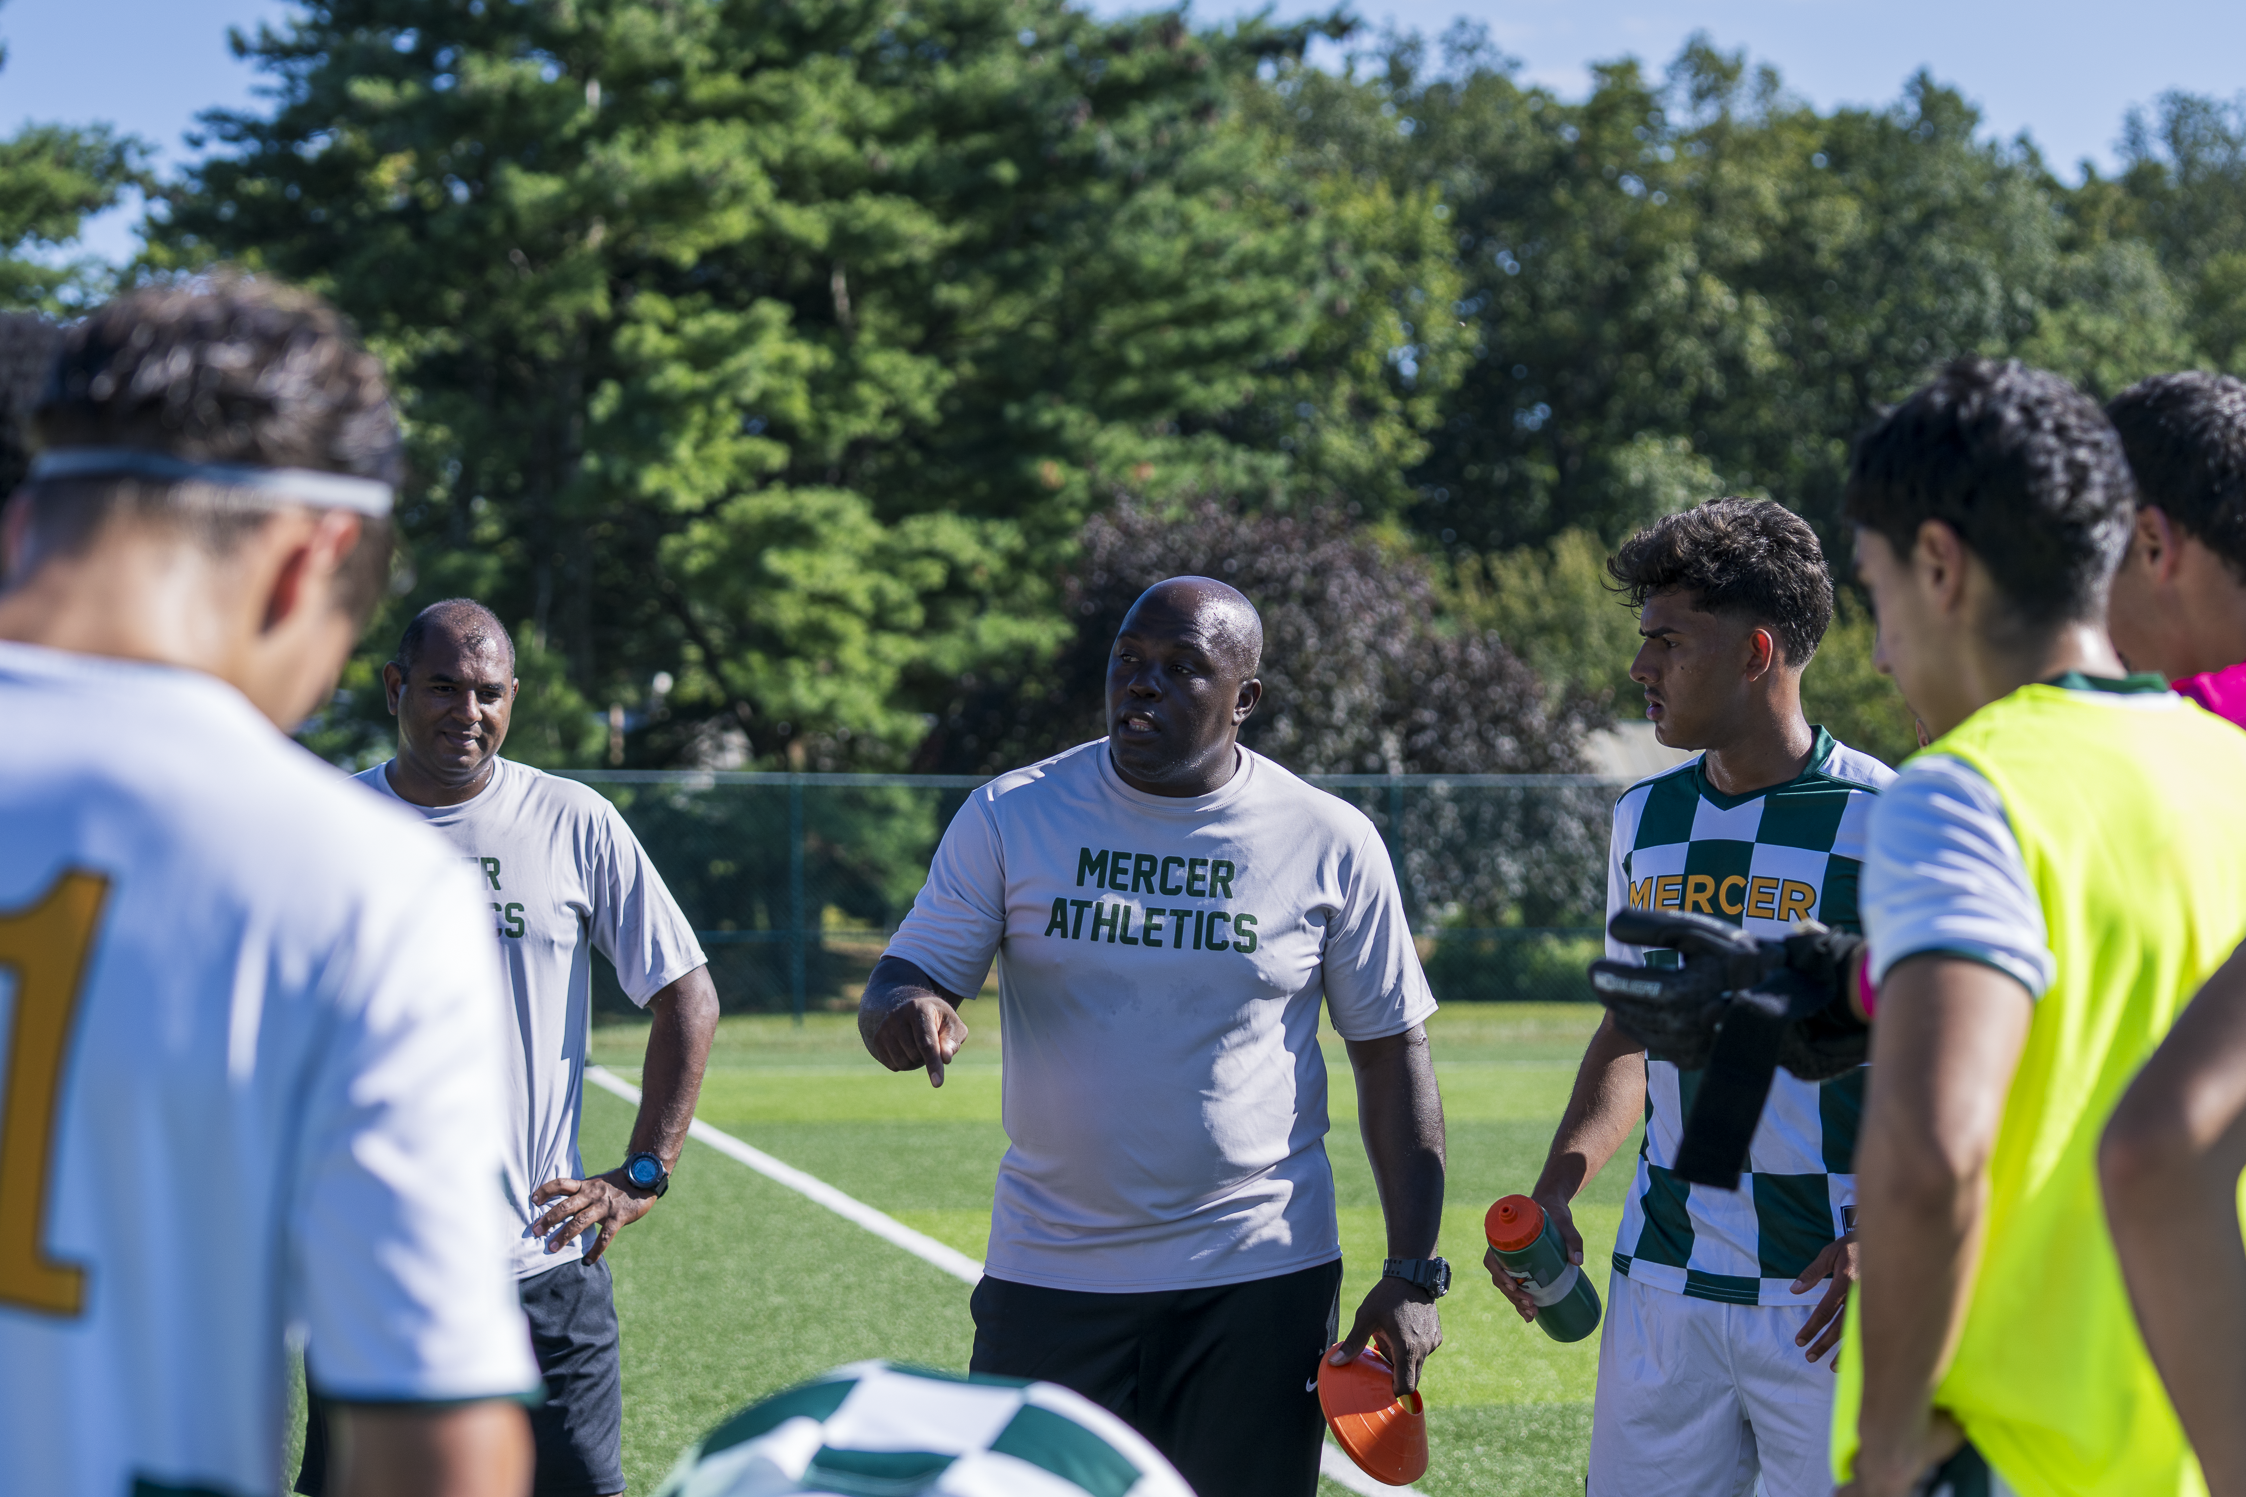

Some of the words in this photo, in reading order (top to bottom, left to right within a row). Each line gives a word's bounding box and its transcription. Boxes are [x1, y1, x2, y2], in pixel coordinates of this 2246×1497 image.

[1076, 847, 1235, 899] MERCER
[1629, 874, 1817, 922] MERCER
[1044, 897, 1258, 954] ATHLETICS
